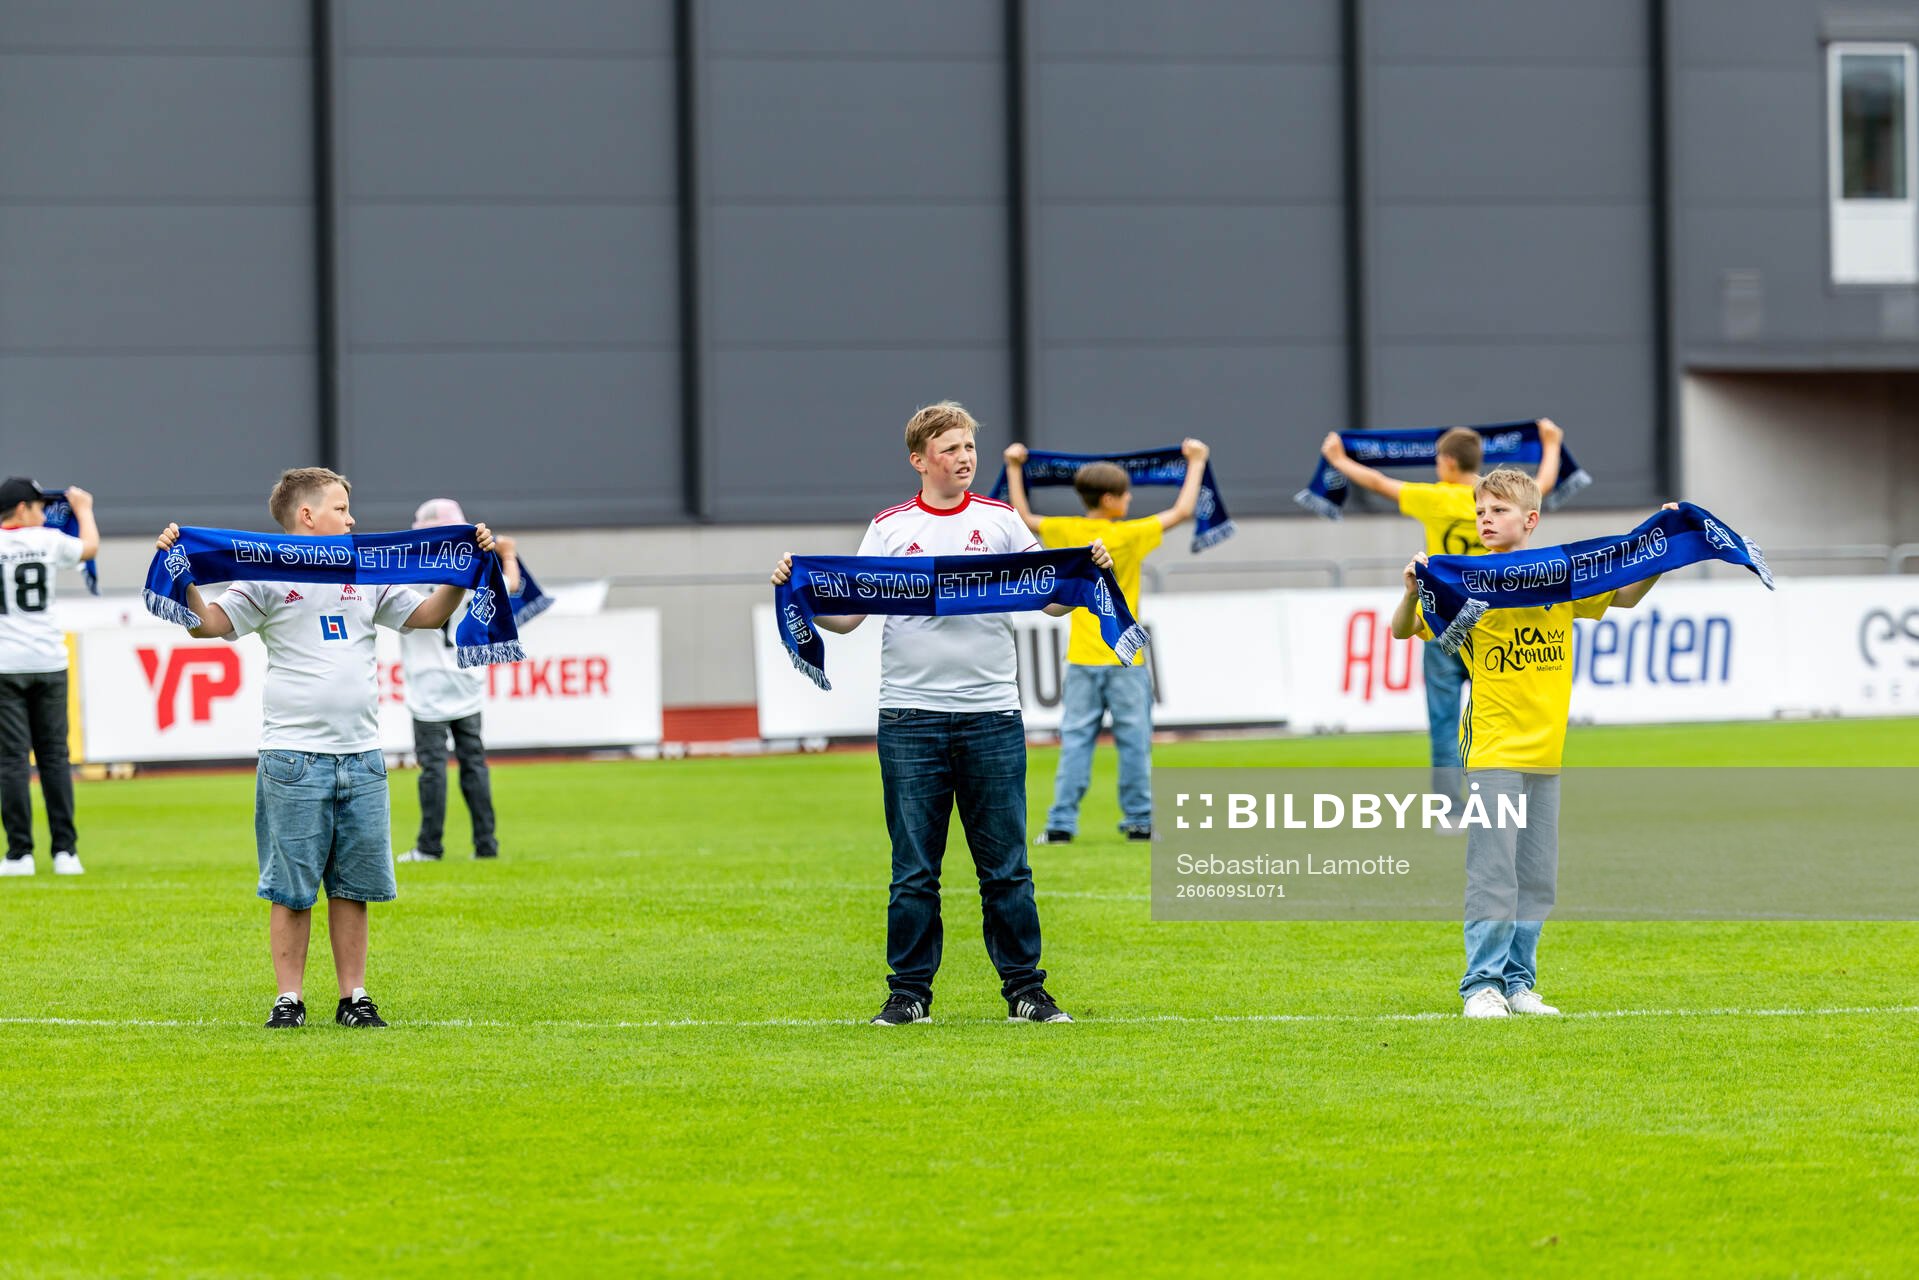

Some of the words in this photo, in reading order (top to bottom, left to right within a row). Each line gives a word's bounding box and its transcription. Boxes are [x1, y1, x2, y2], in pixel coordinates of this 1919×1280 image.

[232, 539, 273, 563] EN
[280, 544, 351, 566] STAD
[359, 542, 413, 568] ETT
[419, 541, 473, 571] LAG
[1461, 569, 1497, 594] EN
[1502, 558, 1567, 592] STAD
[1572, 545, 1616, 582] ETT
[1621, 527, 1668, 568] LAG
[808, 570, 850, 598] EN
[857, 572, 931, 599] STAD
[938, 571, 993, 599] ETT
[1000, 564, 1056, 596] LAG
[1514, 627, 1547, 646] ICA
[1485, 640, 1565, 673] Kronan
[135, 647, 242, 732] YP
